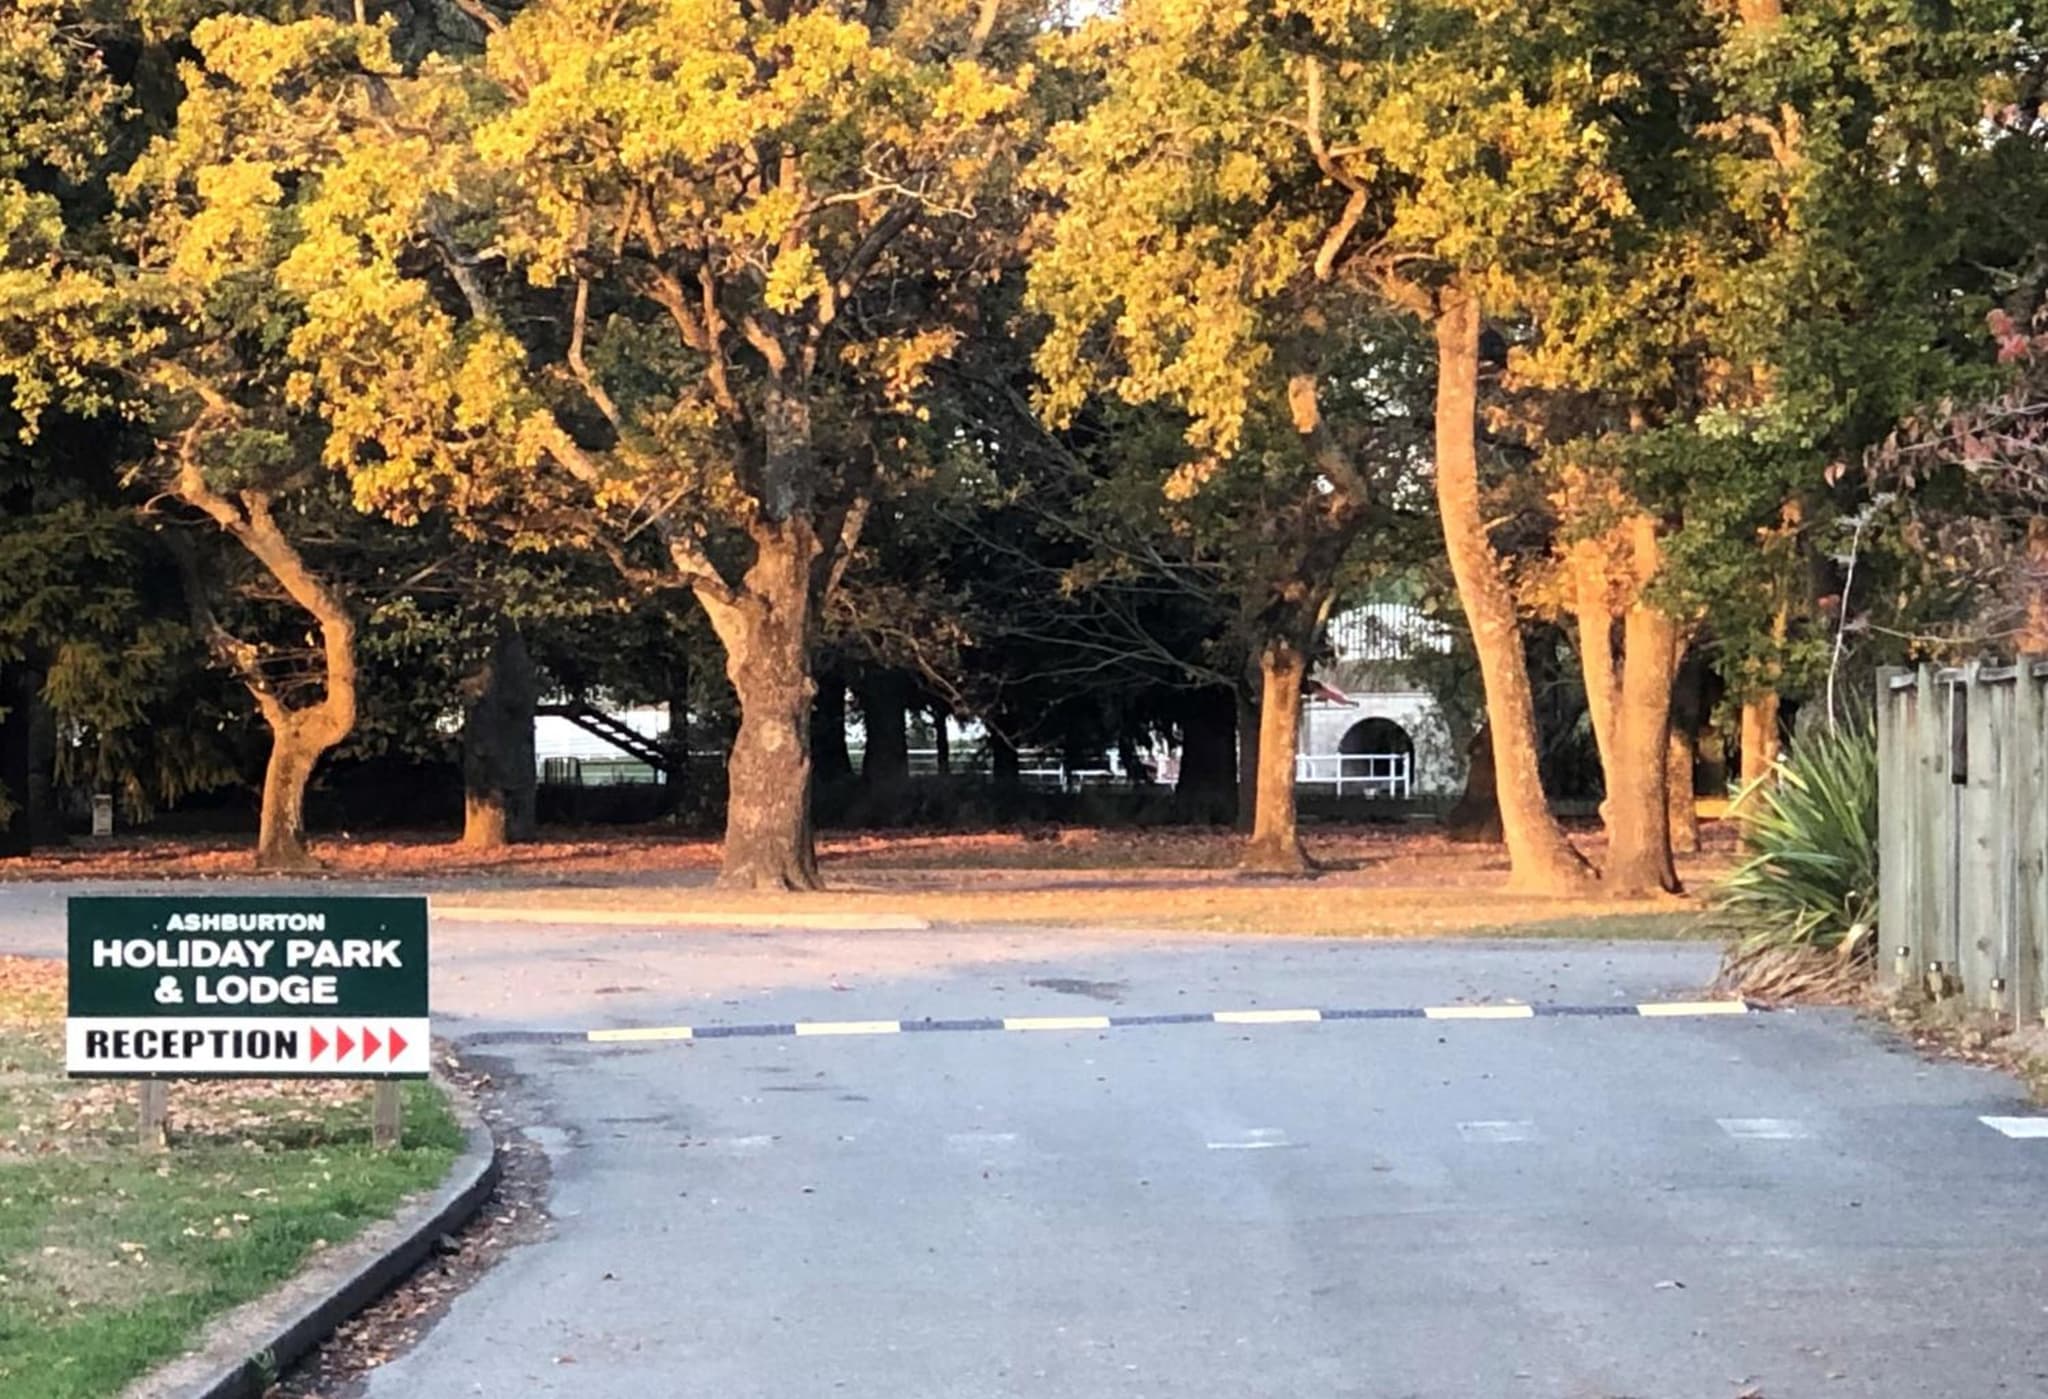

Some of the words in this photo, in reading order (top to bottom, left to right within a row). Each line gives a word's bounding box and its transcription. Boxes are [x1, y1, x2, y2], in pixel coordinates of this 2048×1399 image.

[166, 913, 326, 932] ASHBURTON
[92, 938, 275, 968] HOLIDAY
[286, 938, 403, 968] PARK
[154, 975, 184, 1004] &
[195, 974, 339, 1005] LODGE
[86, 1029, 298, 1060] RECEPTION
